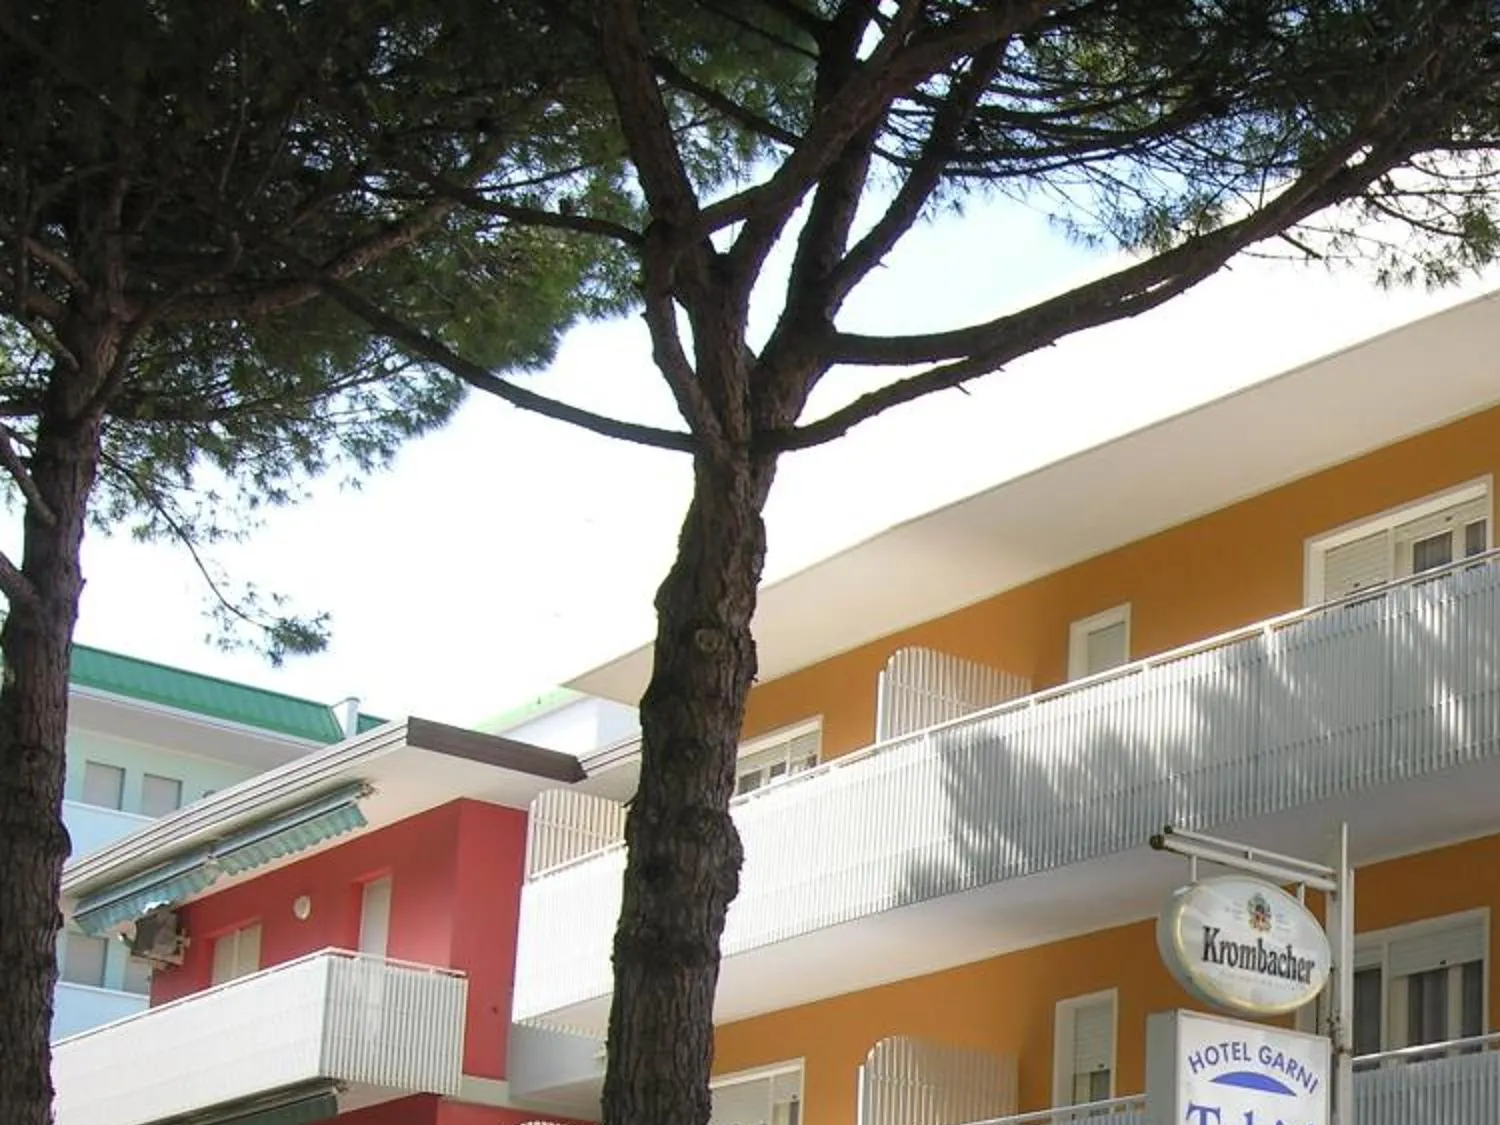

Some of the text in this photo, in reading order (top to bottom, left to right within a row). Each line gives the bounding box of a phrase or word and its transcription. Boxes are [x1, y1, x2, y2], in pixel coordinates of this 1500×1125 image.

[1202, 924, 1316, 985] Krombacher
[1188, 1041, 1319, 1095] HOTEL GARNI
